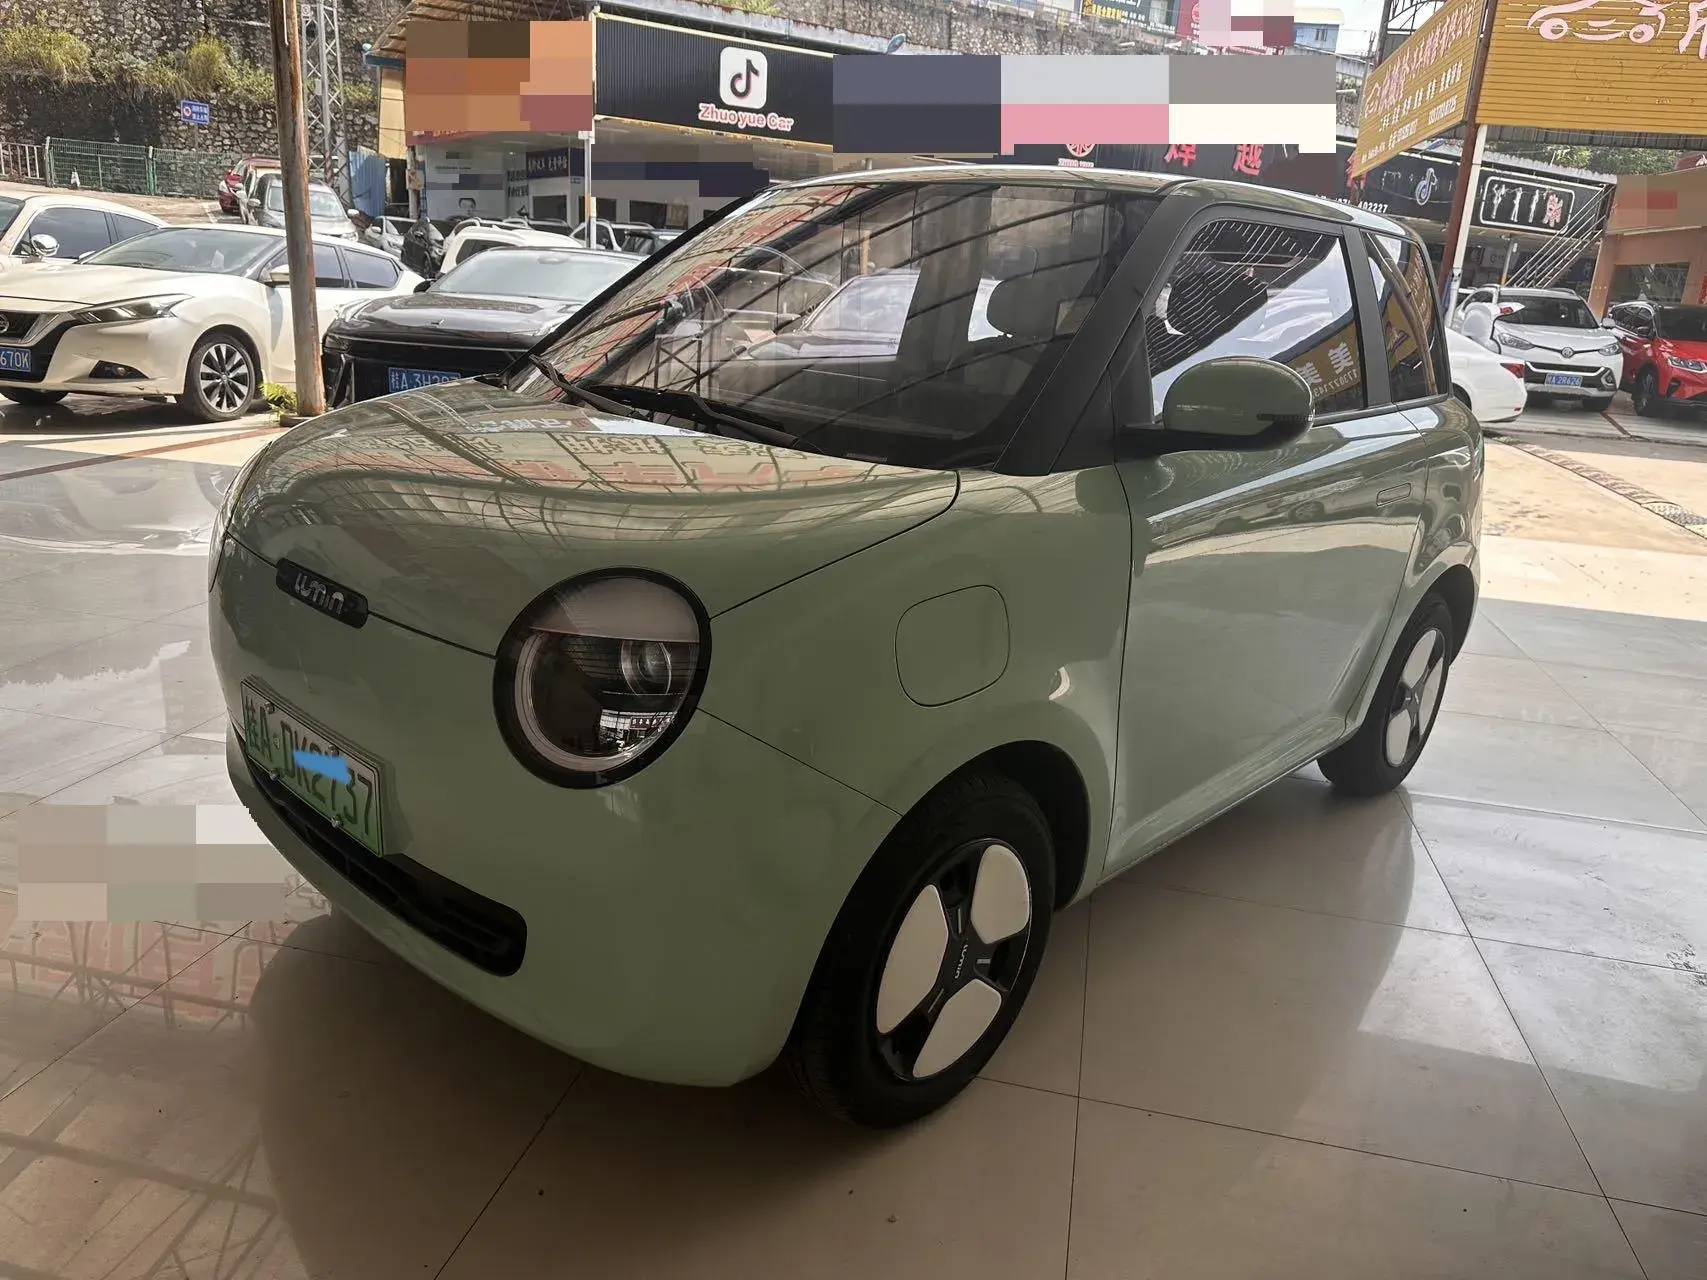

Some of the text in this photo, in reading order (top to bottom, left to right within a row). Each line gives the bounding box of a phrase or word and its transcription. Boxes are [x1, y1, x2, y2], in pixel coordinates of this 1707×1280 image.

[698, 103, 794, 131] Zhuo yue Car
